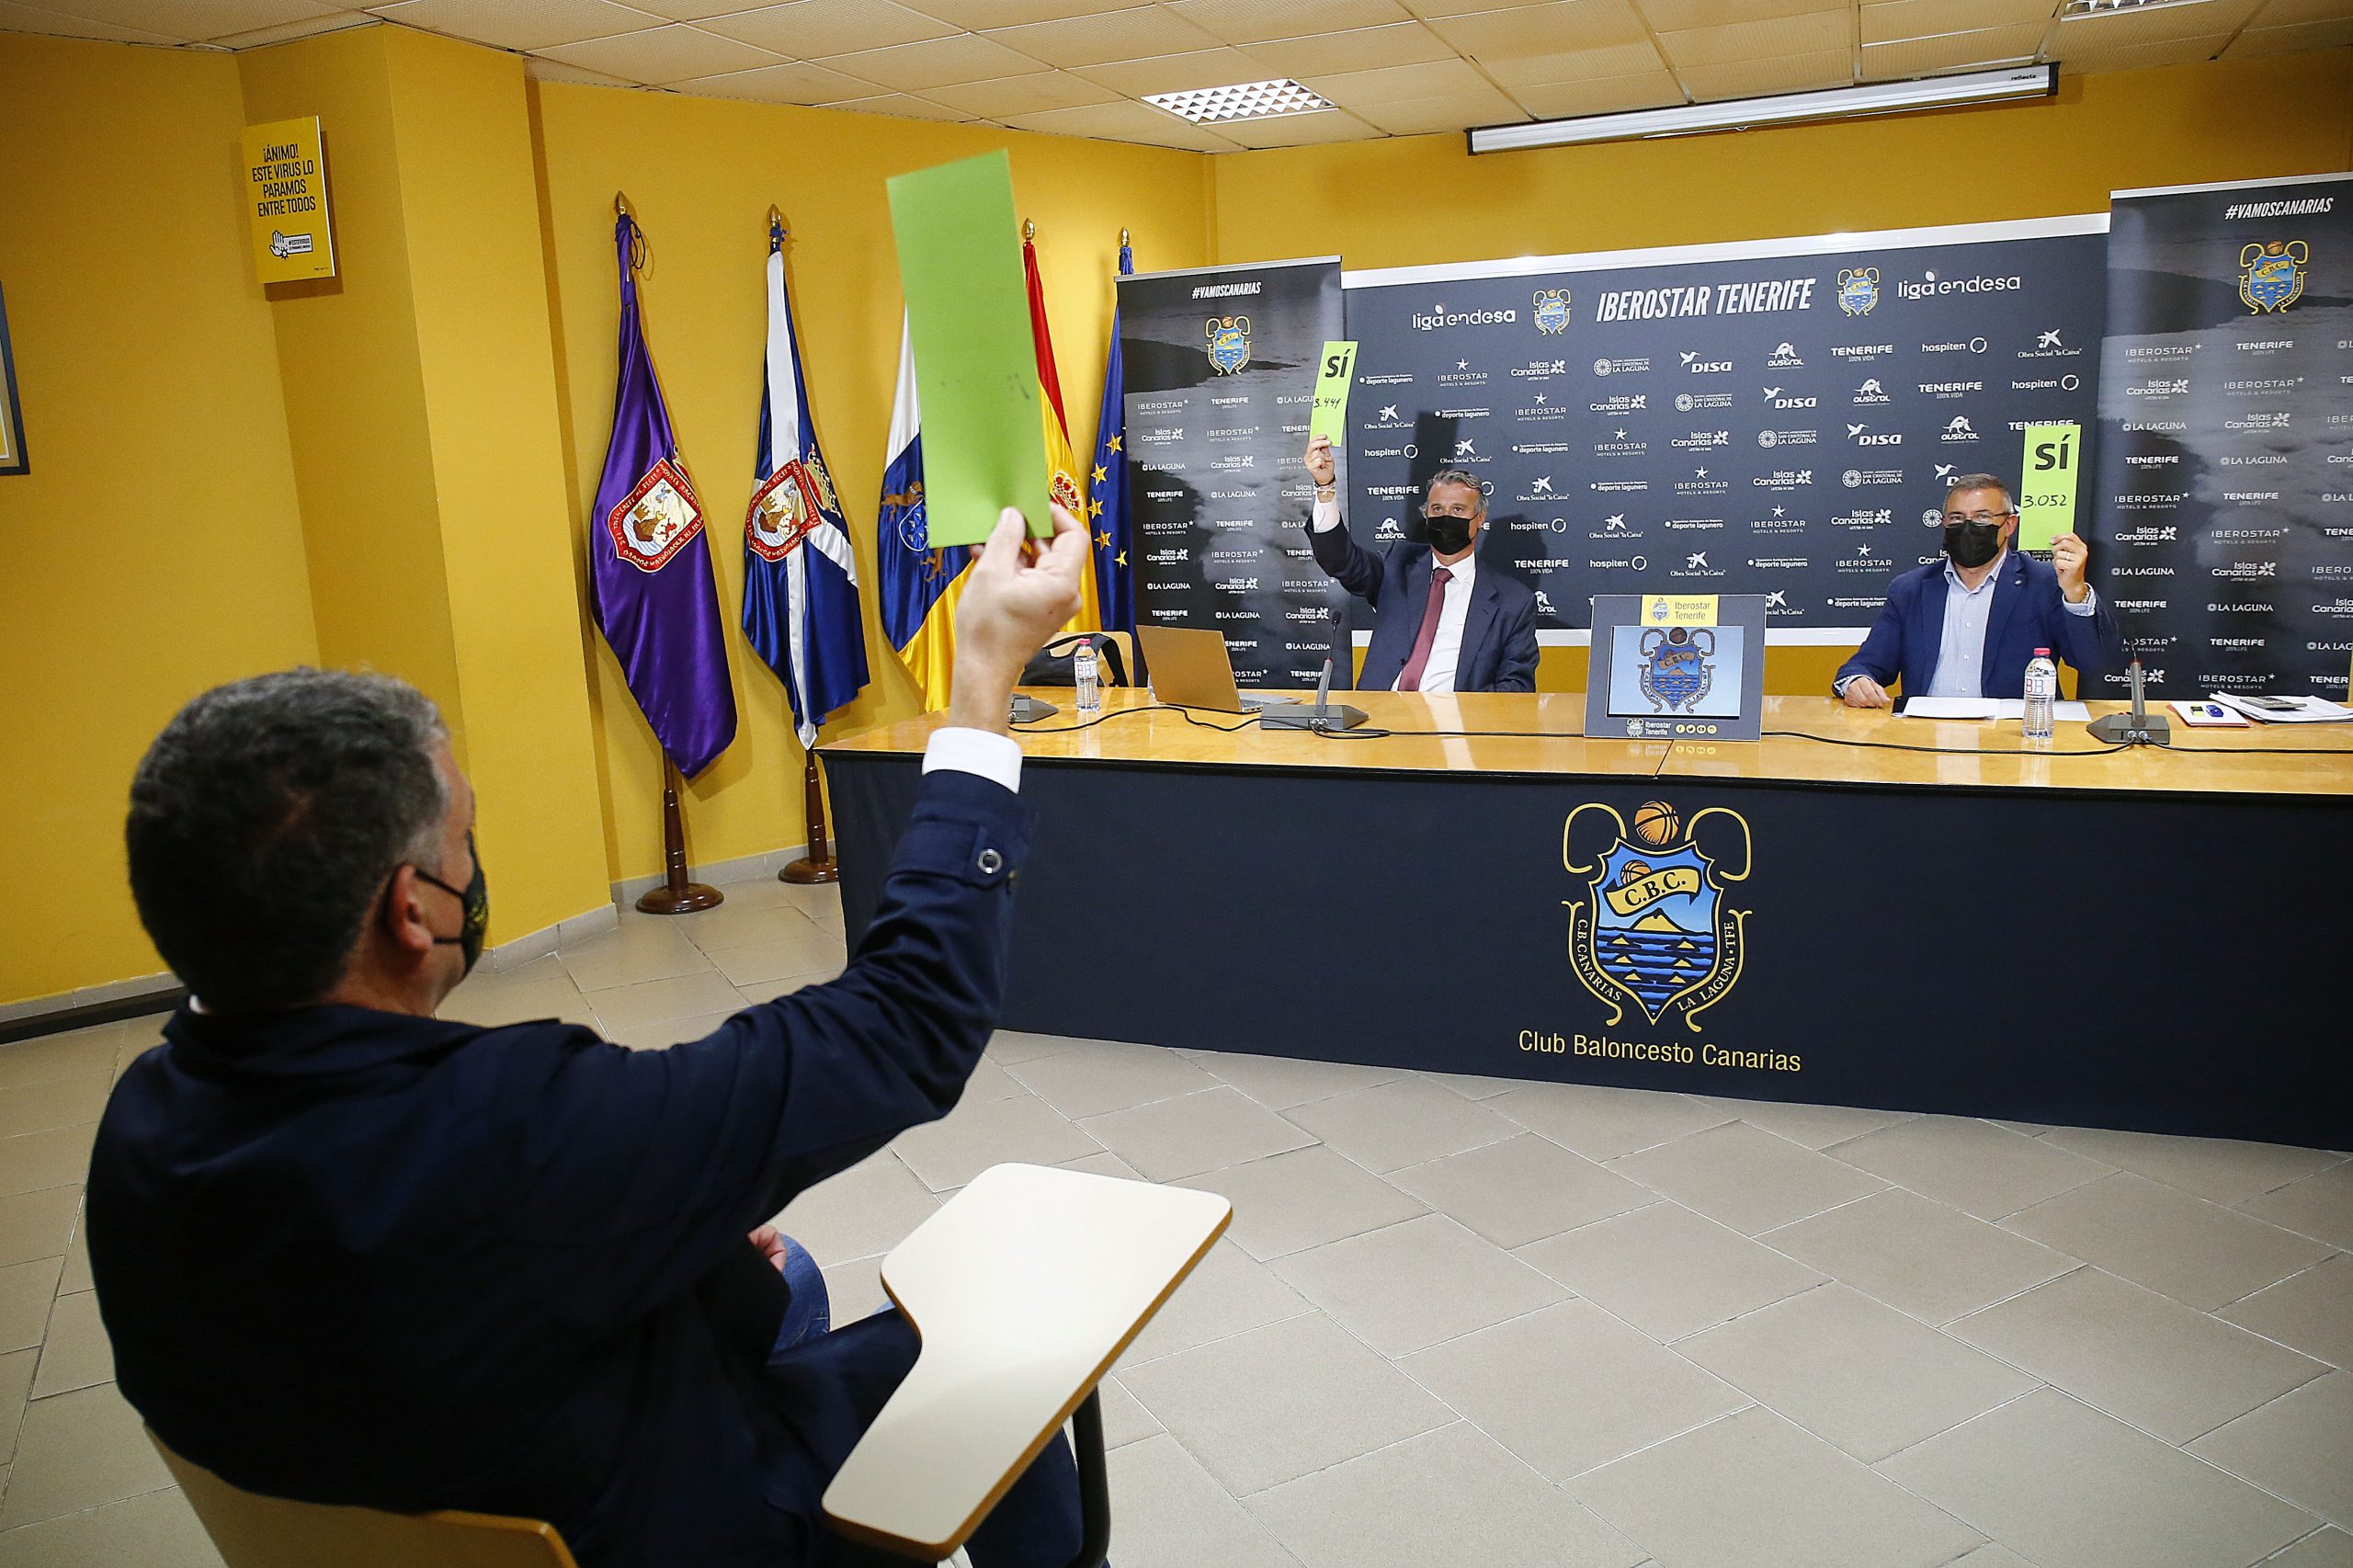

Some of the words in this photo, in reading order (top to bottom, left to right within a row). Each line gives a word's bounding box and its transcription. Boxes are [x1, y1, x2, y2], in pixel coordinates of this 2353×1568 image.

[263, 143, 299, 163] ¡ÁNIMO!
[252, 166, 273, 182] ESTE
[274, 162, 301, 179] VIRUS
[303, 160, 313, 175] LO
[263, 179, 306, 199] PARAMOS
[257, 199, 285, 217] ENTRE
[287, 196, 315, 213] TODOS
[2224, 198, 2334, 220] #VAMOSCANARIAS
[1192, 281, 1262, 300] #VAMOSCANARIAS
[1898, 280, 1935, 300] liga
[1938, 276, 2020, 295] endesa
[1596, 286, 1711, 322] IBEROSTAR
[1715, 278, 1816, 315] TENERIFE
[1413, 312, 1443, 331] liga
[1447, 309, 1516, 326] endesa
[1922, 342, 1966, 353] hospiten
[2236, 341, 2294, 350] TENERIFE
[1831, 345, 1893, 356] TENERIFE
[2125, 347, 2192, 356] IBEROSTAR
[1325, 348, 1351, 378] SÍ
[1511, 368, 1550, 376] Canarias
[1366, 377, 1386, 385] deporte
[1388, 375, 1413, 384] lagunero
[1438, 373, 1488, 381] IBEROSTAR
[1918, 381, 1983, 393] TENERIFE
[2012, 380, 2057, 391] hospiten
[2148, 380, 2170, 388] Islas
[2224, 380, 2295, 390] IBEROSTAR
[2126, 387, 2170, 395] Canarias
[1138, 402, 1183, 410] IBEROSTAR
[1590, 403, 1630, 411] Canarias
[1441, 411, 1463, 419] deporte
[1464, 410, 1490, 418] lagunero
[1516, 407, 1566, 415] IBEROSTAR
[2224, 421, 2271, 429] Canarias
[1207, 428, 1254, 437] IBEROSTAR
[1142, 434, 1171, 442] Canarias
[1364, 449, 1401, 459] hospiten
[1519, 446, 1540, 454] deporte
[1542, 445, 1568, 453] lagunero
[2035, 434, 2070, 471] SÍ
[2125, 456, 2179, 464] TENERIFE
[1753, 478, 1795, 486] Canarias
[1368, 485, 1419, 495] TENERIFE
[1597, 483, 1620, 492] deporte
[1281, 489, 1312, 497] Canarias
[2023, 494, 2067, 508] 3.052
[2115, 494, 2180, 503] IBEROSTAR
[1851, 509, 1873, 517] Islas
[1510, 521, 1548, 531] hospiten
[1831, 517, 1874, 526] Canarias
[2115, 533, 2159, 541] Canarias
[2211, 529, 2280, 538] IBEROSTAR
[1515, 560, 1569, 568] TENERIFE
[1590, 559, 1629, 569] hospiten
[1836, 560, 1893, 568] IBEROSTAR
[2211, 568, 2257, 576] Canarias
[1676, 611, 1706, 619] Tenerife
[2210, 638, 2265, 646] TENERIFE
[2199, 675, 2267, 683] IBEROSTAR
[1624, 871, 1687, 906] C.B.C.
[1576, 944, 1622, 1001] CANARIAS
[1677, 997, 1696, 1011] LA
[1699, 957, 1735, 1001] LAGUNA
[1518, 1030, 1565, 1054] Club
[1574, 1035, 1694, 1064] Baloncesto
[1702, 1044, 1802, 1072] Canarias
